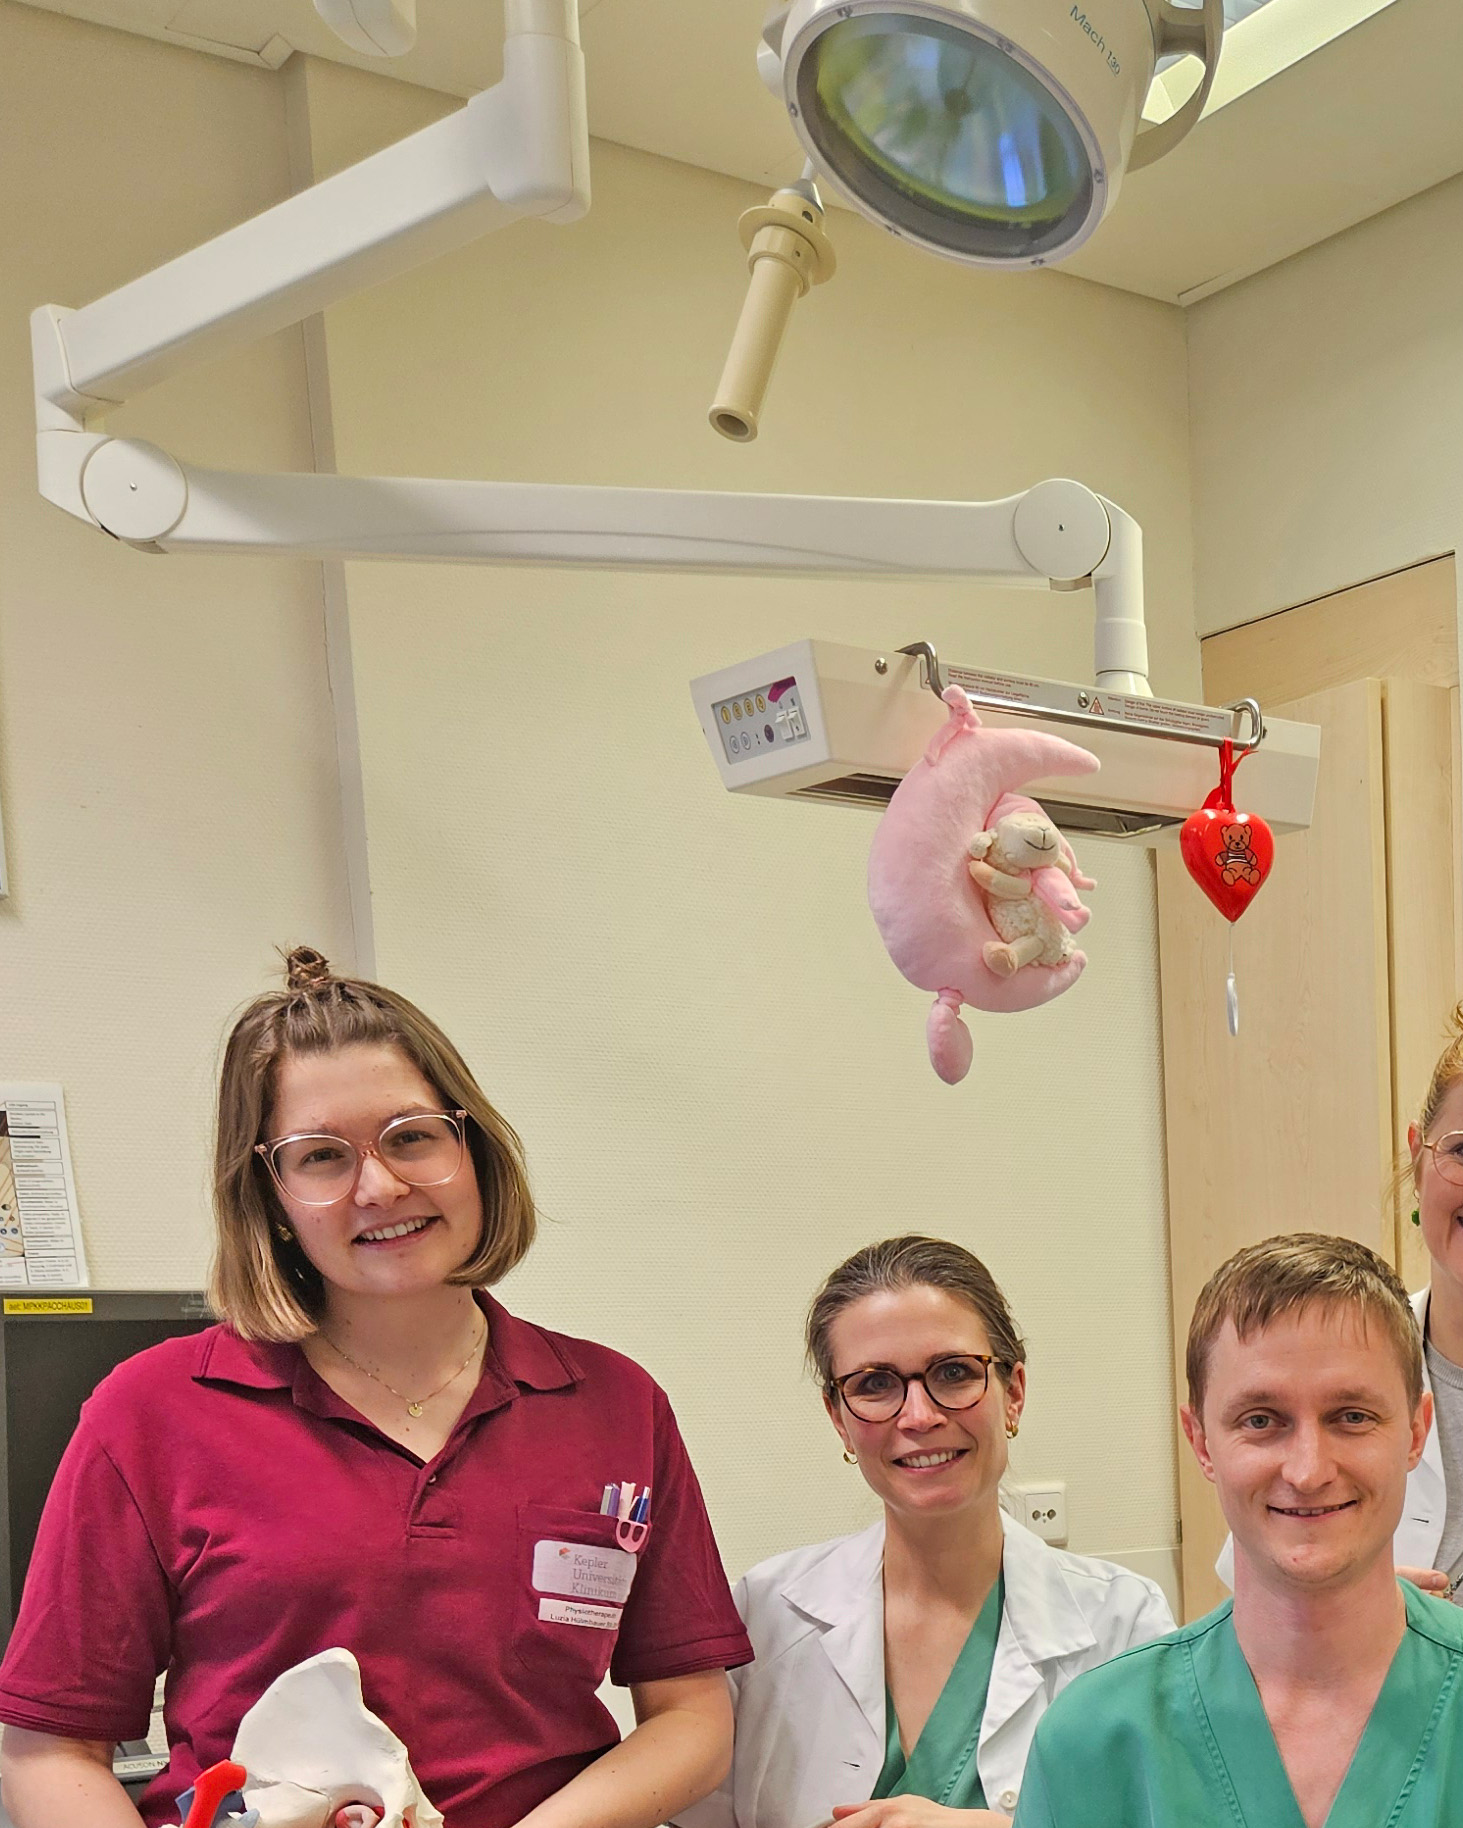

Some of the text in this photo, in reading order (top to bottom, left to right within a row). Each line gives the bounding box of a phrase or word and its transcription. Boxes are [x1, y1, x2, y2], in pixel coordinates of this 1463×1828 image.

[1070, 5, 1105, 54] Mach
[573, 1554, 609, 1569] Kepler
[571, 1582, 617, 1598] Klinikum
